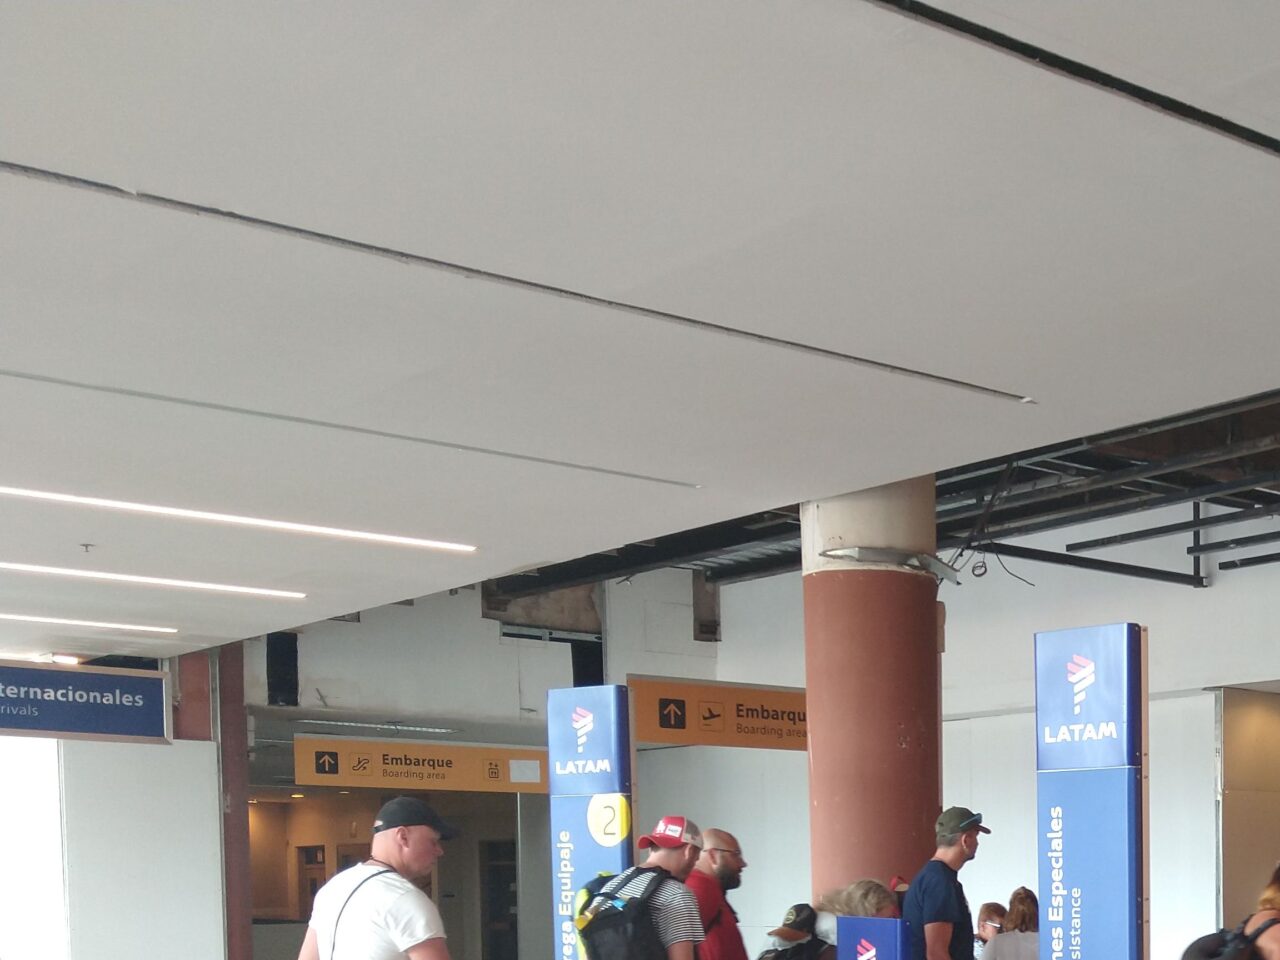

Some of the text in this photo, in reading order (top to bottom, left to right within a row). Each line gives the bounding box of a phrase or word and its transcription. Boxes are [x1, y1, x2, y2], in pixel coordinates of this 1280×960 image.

[735, 703, 807, 725] Embarqu
[736, 722, 783, 738] Boarding
[1044, 721, 1118, 744] LATAM
[382, 753, 453, 769] Embarque
[555, 759, 611, 775] LATAM
[382, 768, 446, 780] Boarding area
[603, 805, 617, 836] 2
[556, 830, 574, 916] Equipaje
[1047, 806, 1067, 922] Especiales
